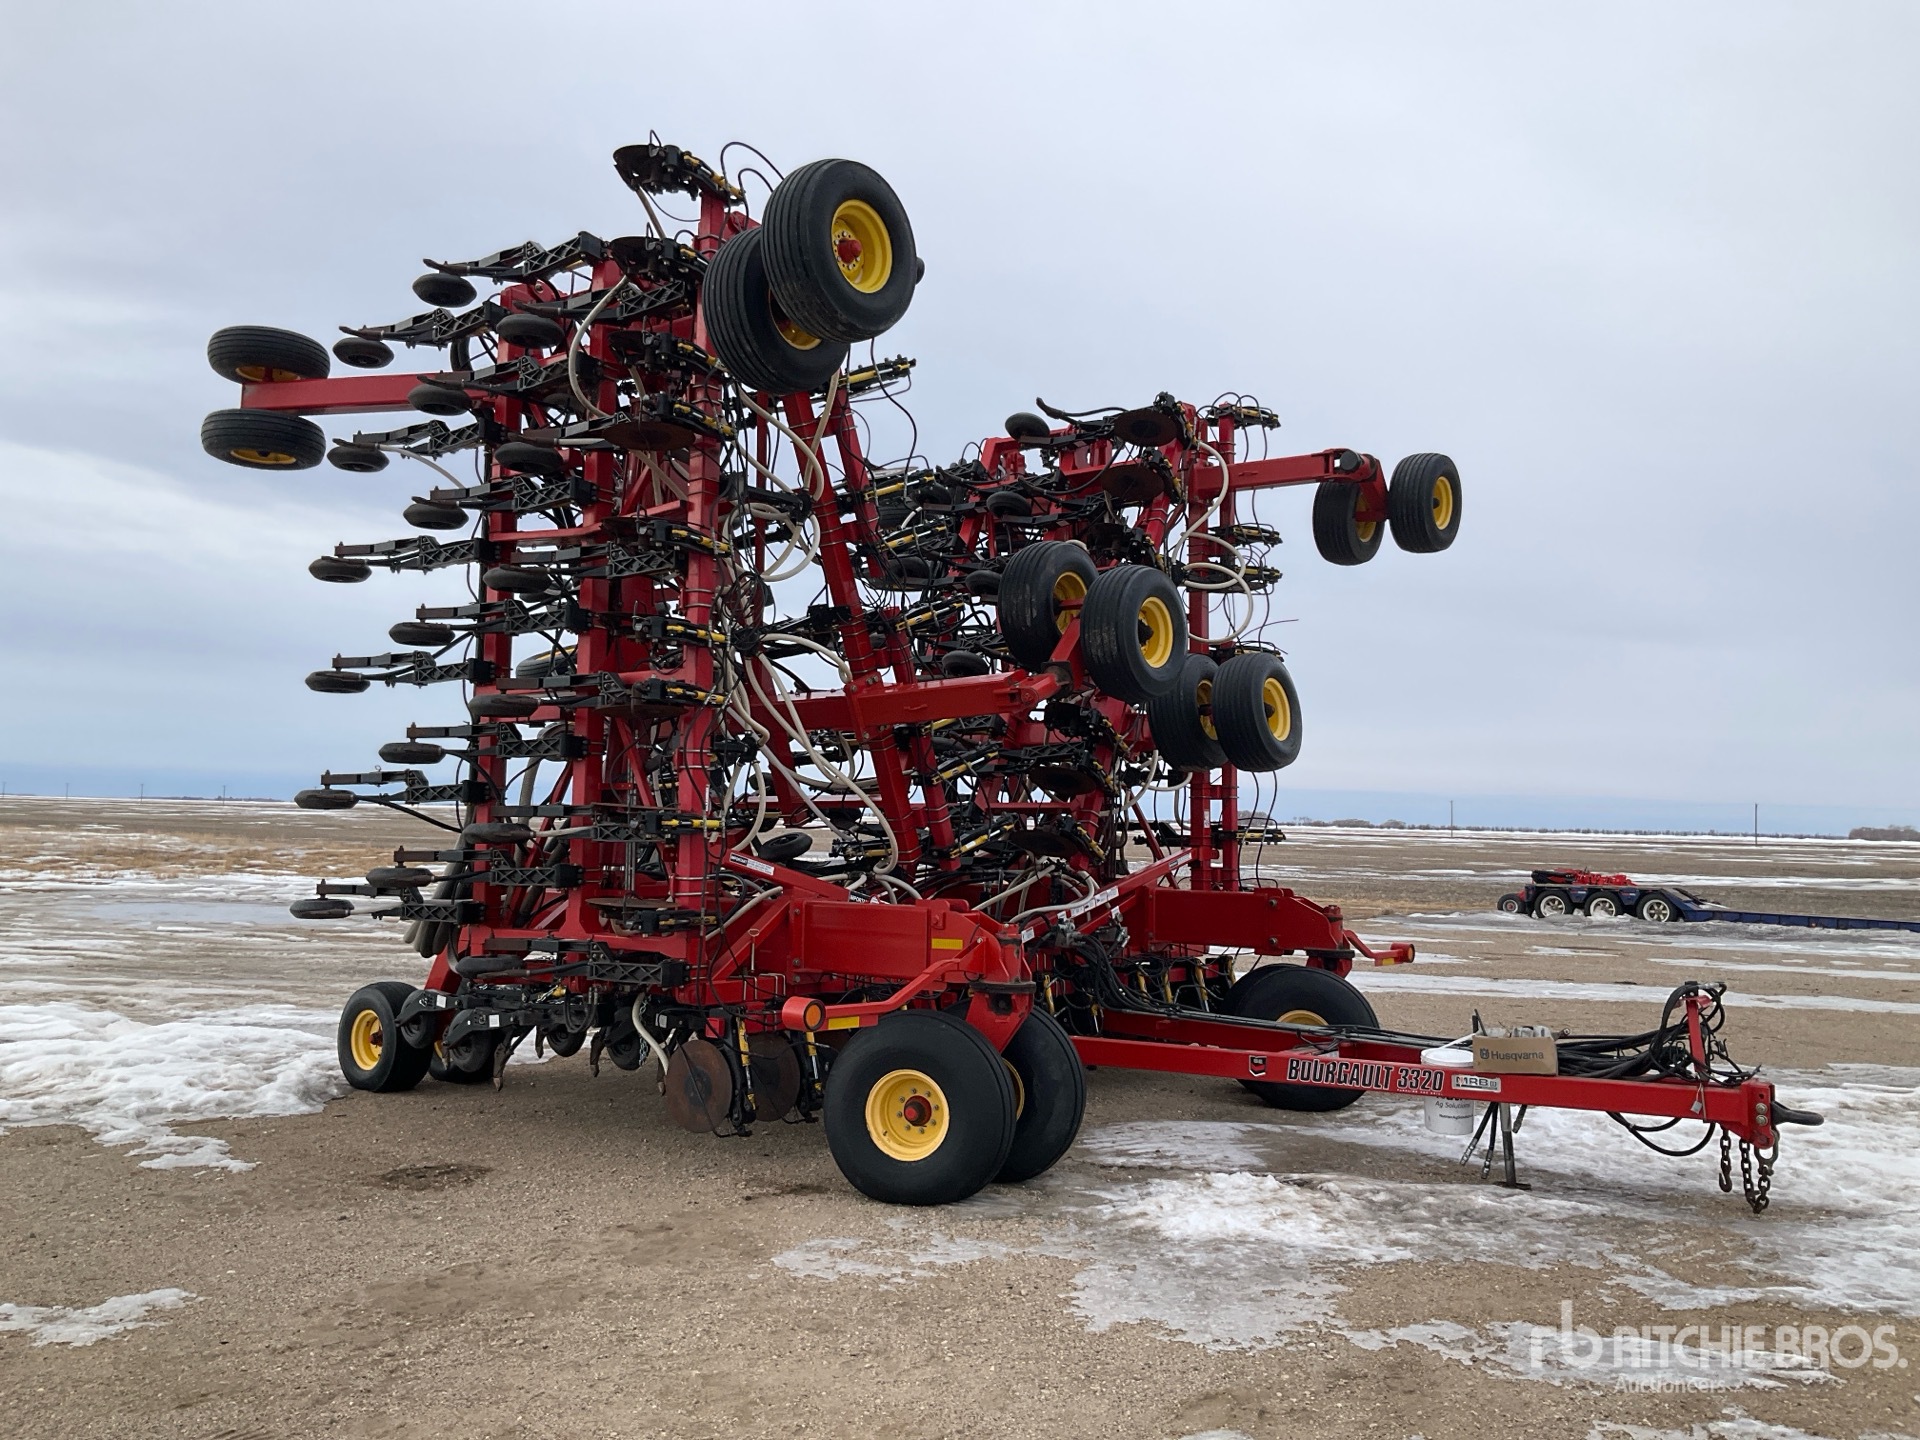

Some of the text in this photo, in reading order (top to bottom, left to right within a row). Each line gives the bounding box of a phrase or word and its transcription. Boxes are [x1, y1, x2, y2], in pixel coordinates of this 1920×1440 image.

[1491, 1051, 1544, 1061] Husqvarna
[1287, 1058, 1445, 1092] BOURGAULT 3320
